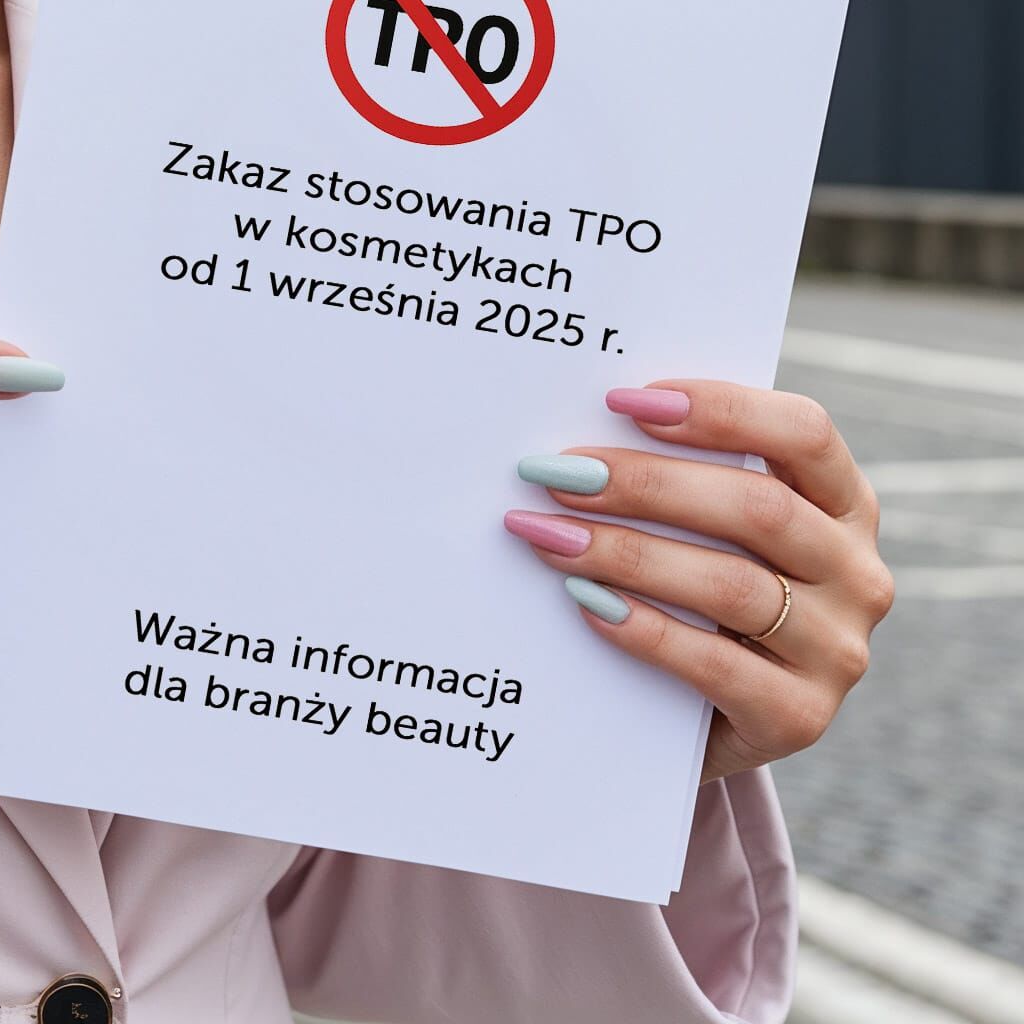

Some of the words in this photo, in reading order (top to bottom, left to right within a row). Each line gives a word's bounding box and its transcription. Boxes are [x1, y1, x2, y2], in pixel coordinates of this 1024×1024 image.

[162, 141, 291, 193] Zakaz
[304, 171, 551, 237] stosowania
[569, 207, 662, 254] TPO
[234, 213, 272, 241] w
[285, 214, 572, 293] kosmetykach
[160, 253, 219, 286] od
[231, 258, 252, 293] 1
[269, 271, 459, 327] września
[474, 299, 586, 347] 2025
[601, 327, 624, 355] r.
[134, 609, 275, 664] Ważna
[291, 636, 523, 709] informacja
[124, 664, 187, 703] dla
[204, 674, 353, 736] branży
[365, 701, 515, 762] beauty
